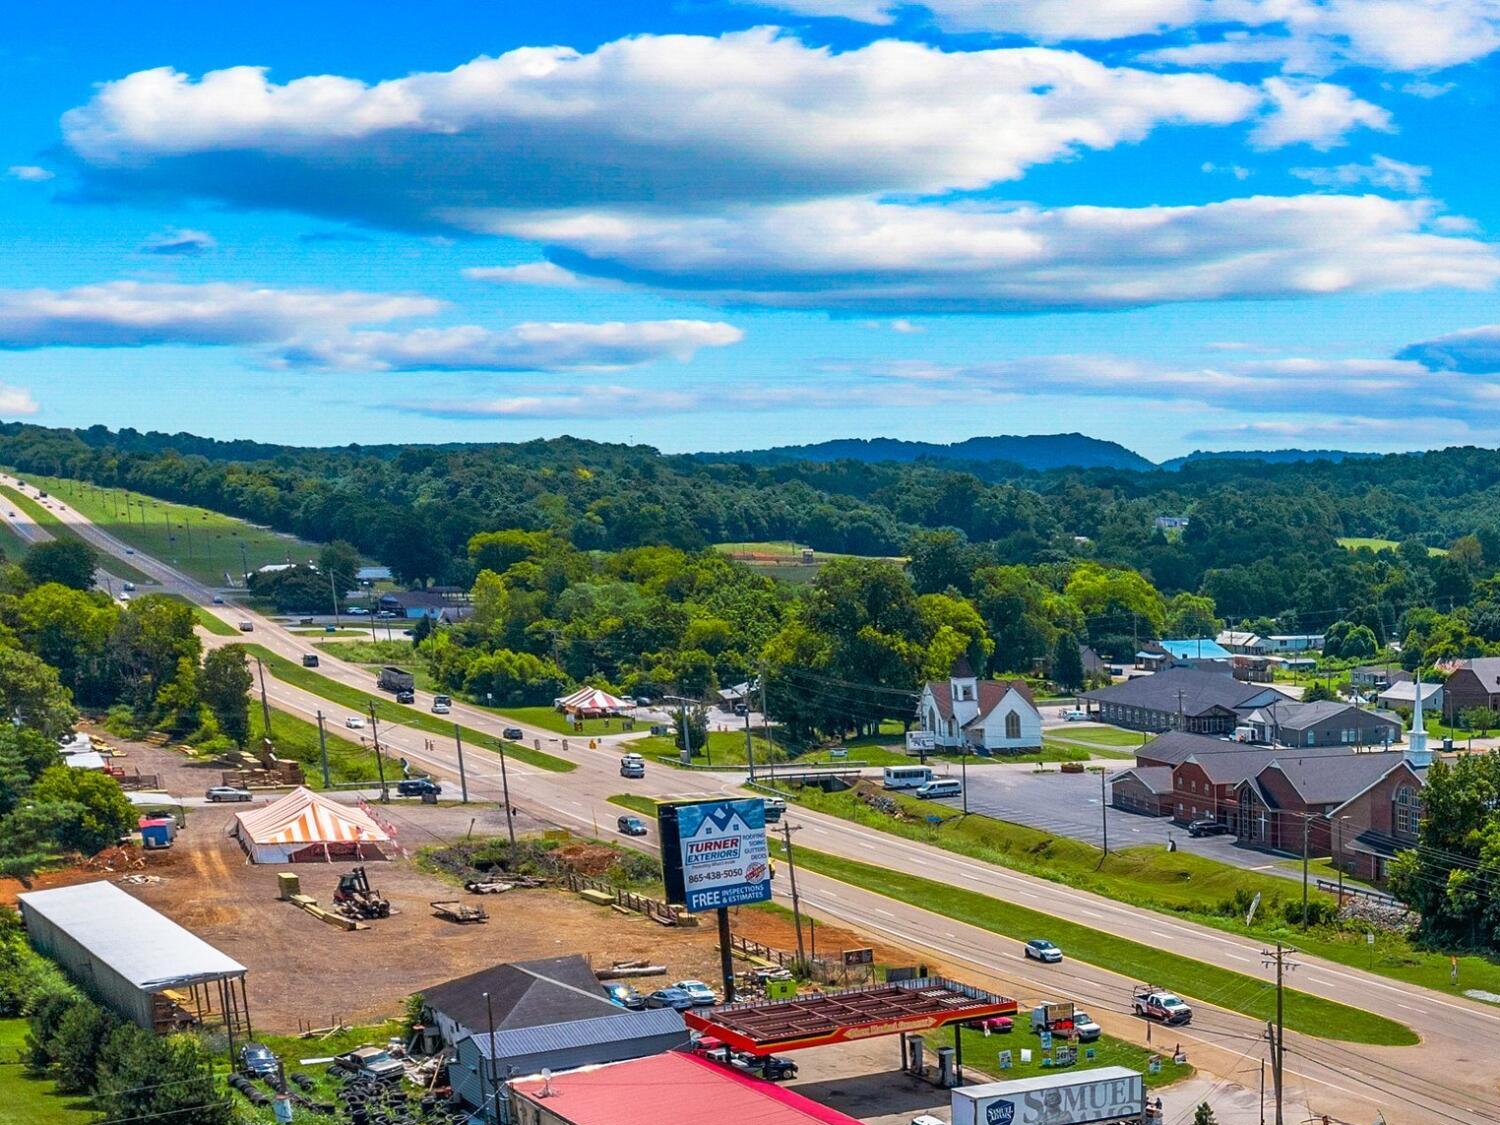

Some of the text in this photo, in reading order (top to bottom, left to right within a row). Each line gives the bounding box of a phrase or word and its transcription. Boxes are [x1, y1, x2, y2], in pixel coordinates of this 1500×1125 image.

[688, 838, 739, 854] TURNER
[687, 849, 738, 863] EXTERIORS
[688, 868, 743, 884] 865-438-5050
[721, 884, 764, 897] INSPECTIONS
[728, 892, 763, 903] ESTIMATES
[692, 891, 721, 909] FREE
[1023, 1076, 1142, 1124] SMUEL
[988, 1105, 1013, 1115] SAMUEL
